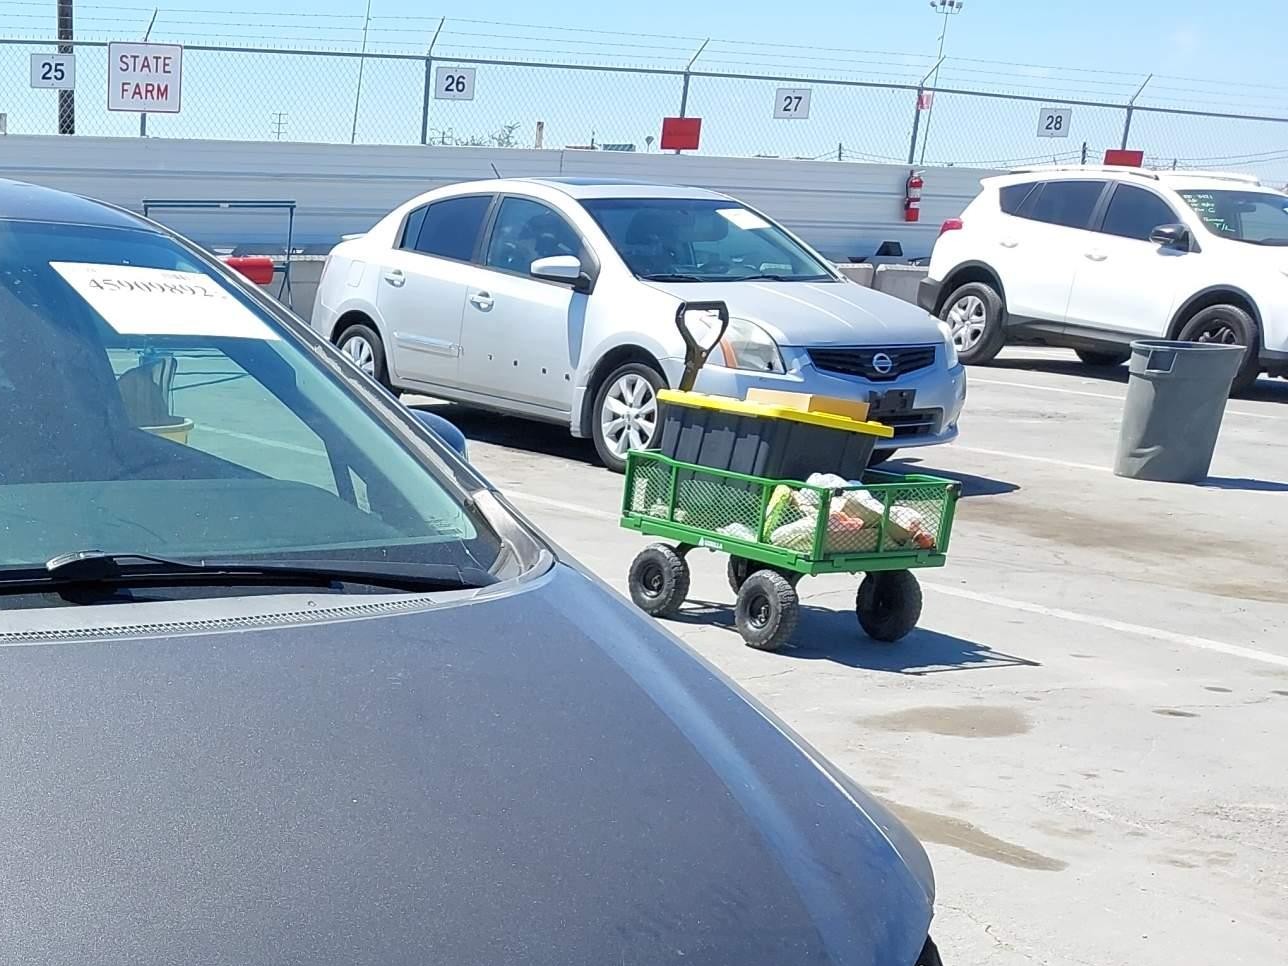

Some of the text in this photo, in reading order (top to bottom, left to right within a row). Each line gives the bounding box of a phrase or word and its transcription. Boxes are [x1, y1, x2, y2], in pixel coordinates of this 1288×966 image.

[41, 62, 65, 81] 25
[119, 54, 172, 74] STATE
[121, 82, 169, 101] FARM
[444, 74, 466, 92] 26
[782, 95, 803, 112] 27
[1045, 115, 1063, 131] 28
